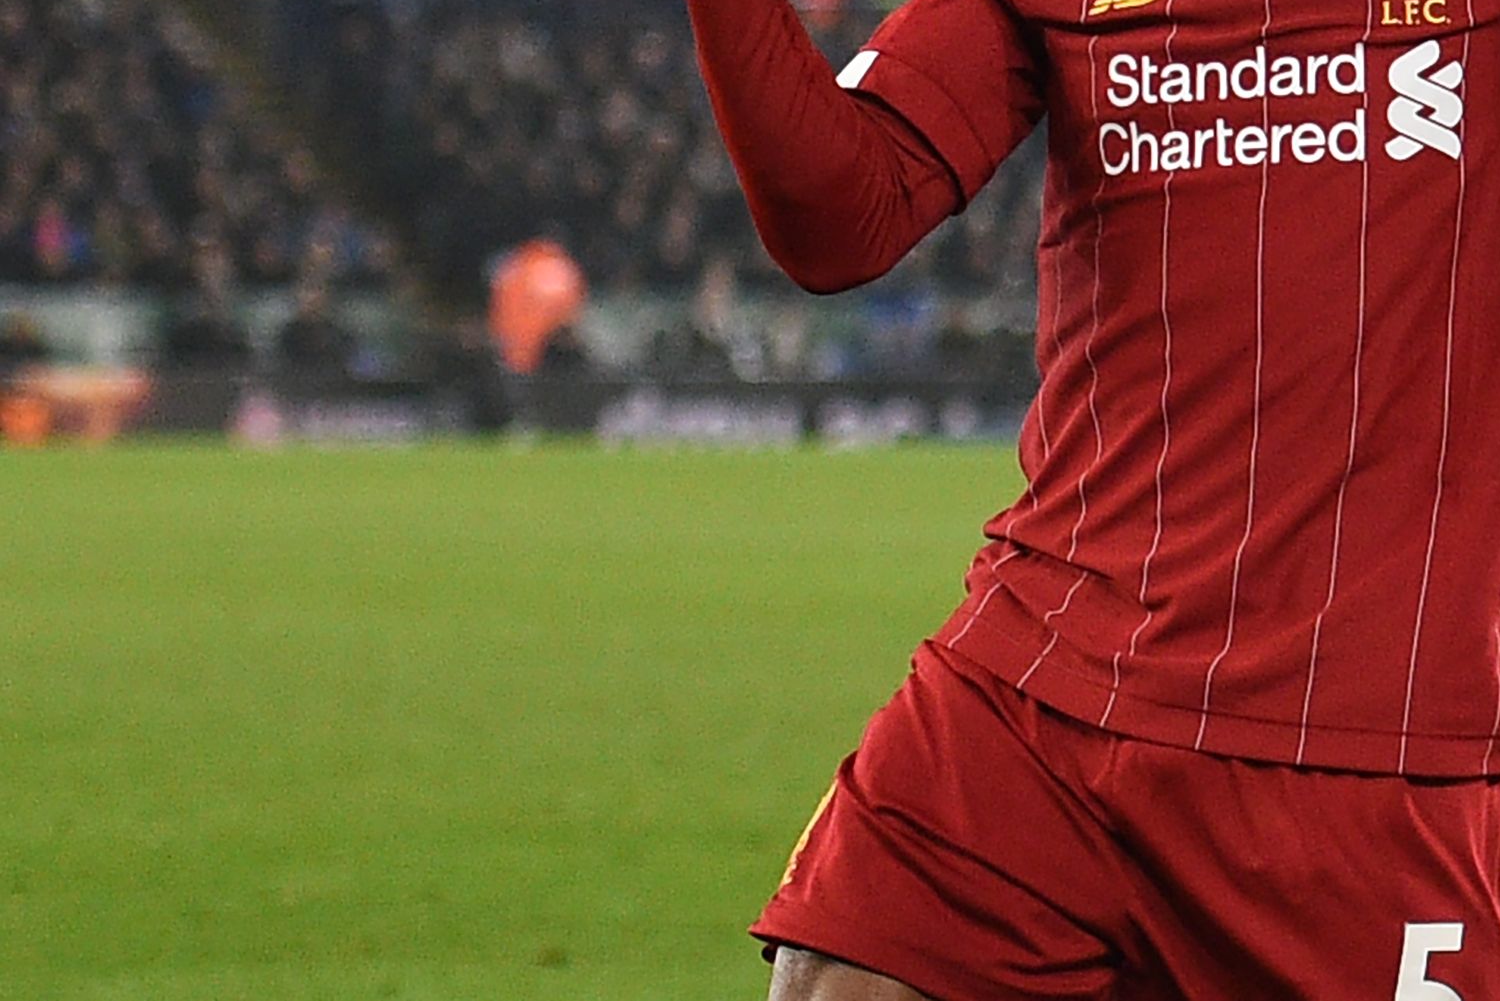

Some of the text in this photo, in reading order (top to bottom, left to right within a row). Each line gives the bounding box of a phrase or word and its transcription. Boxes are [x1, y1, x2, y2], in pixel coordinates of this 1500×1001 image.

[1106, 42, 1366, 108] Standard
[1100, 107, 1366, 175] Chartered
[1394, 922, 1464, 1001] 5
